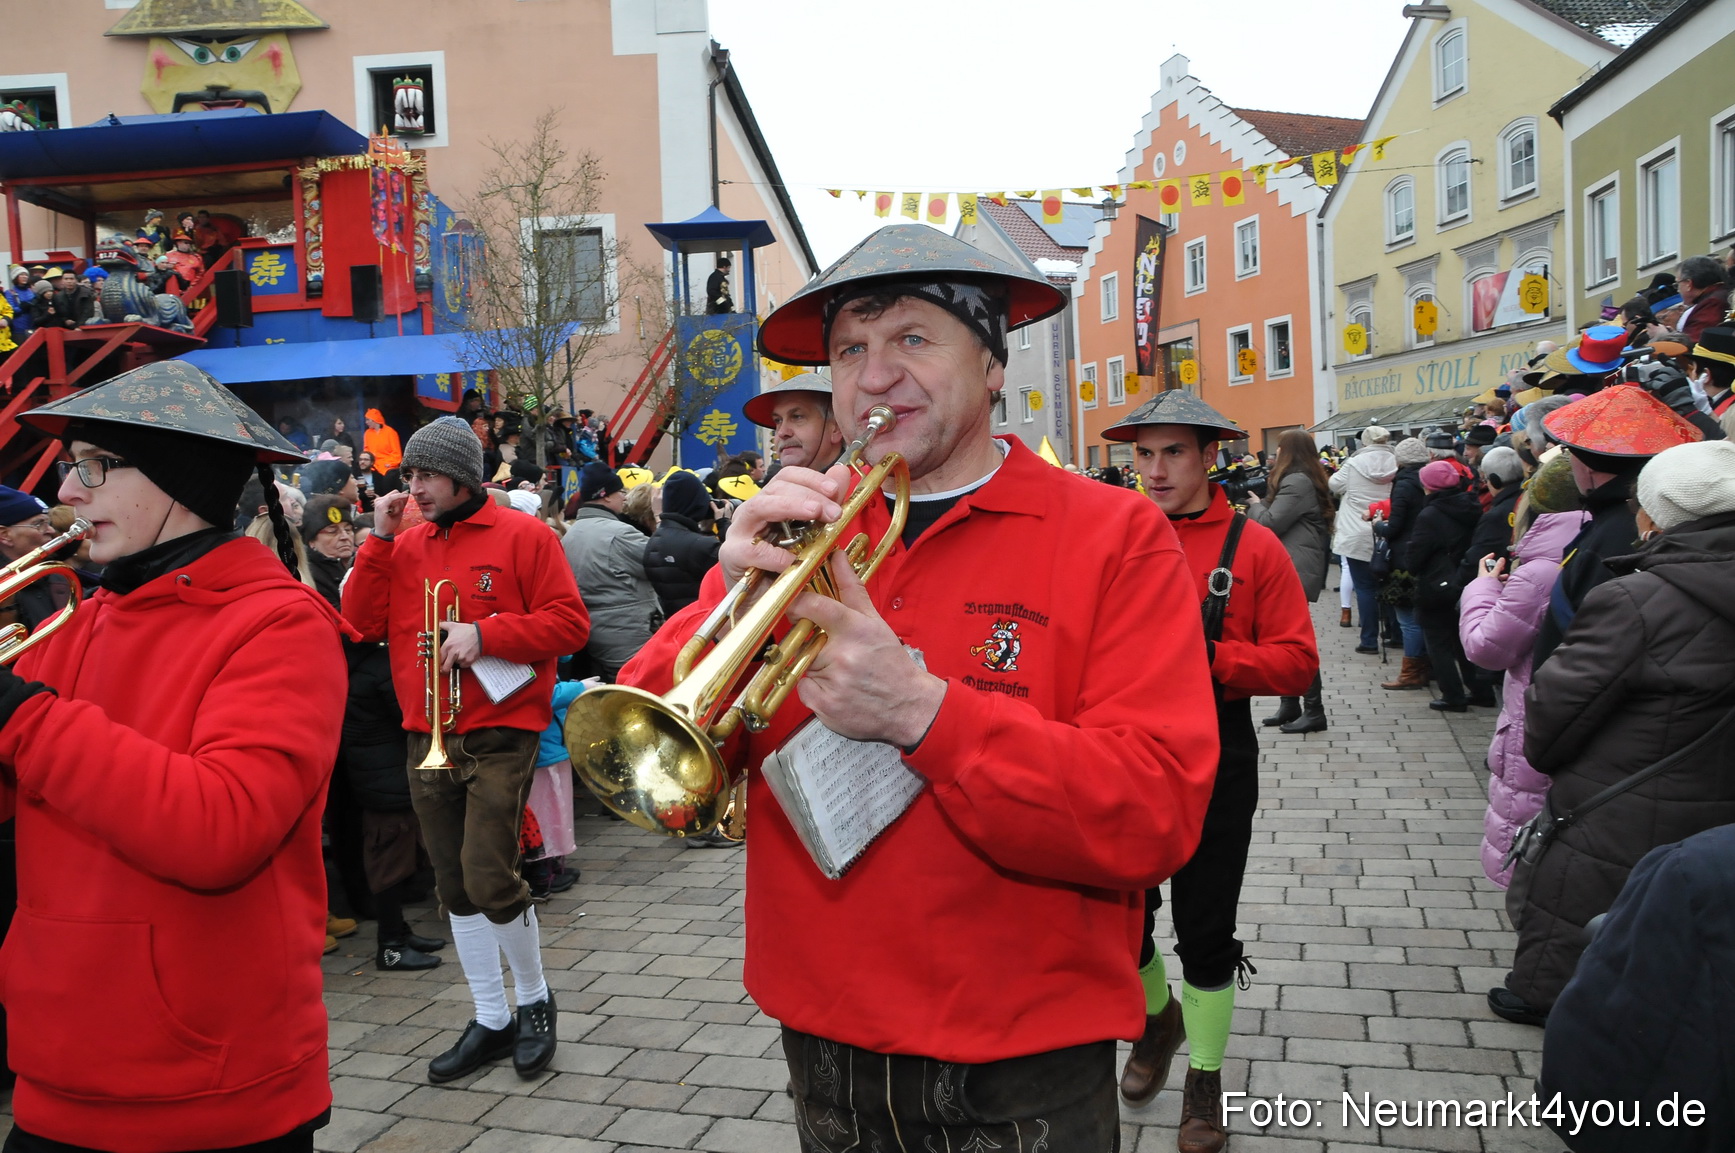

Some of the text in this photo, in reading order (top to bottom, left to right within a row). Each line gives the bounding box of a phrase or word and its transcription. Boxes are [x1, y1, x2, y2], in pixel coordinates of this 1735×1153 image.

[1052, 323, 1063, 438] UHREN SCHMUCK
[1415, 356, 1480, 395] STOLL
